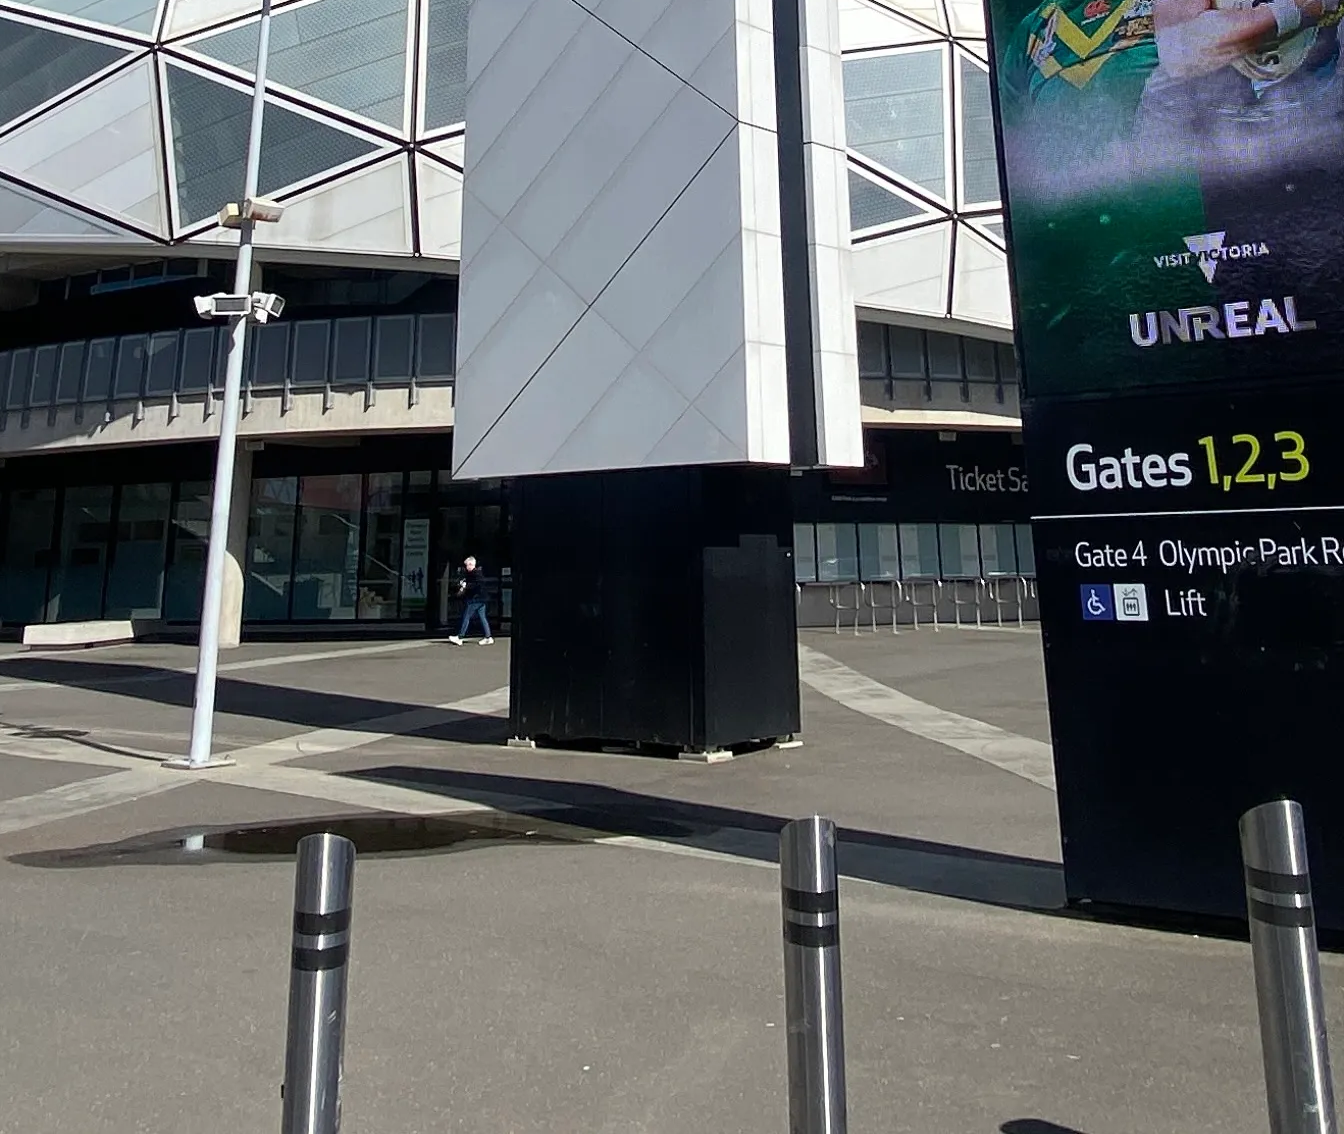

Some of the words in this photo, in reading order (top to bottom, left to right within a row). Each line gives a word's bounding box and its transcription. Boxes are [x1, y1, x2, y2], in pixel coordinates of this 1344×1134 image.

[1153, 252, 1192, 268] VISIT
[1128, 295, 1317, 348] UNREAL
[1065, 443, 1193, 491] Gates
[1198, 431, 1310, 491] 1,2,3
[945, 464, 1006, 492] Ticket
[1075, 542, 1128, 568] Gate
[1131, 540, 1148, 567] 4
[1159, 540, 1255, 574] Olympic
[1259, 537, 1319, 566] Park
[1164, 588, 1208, 617] Lift
